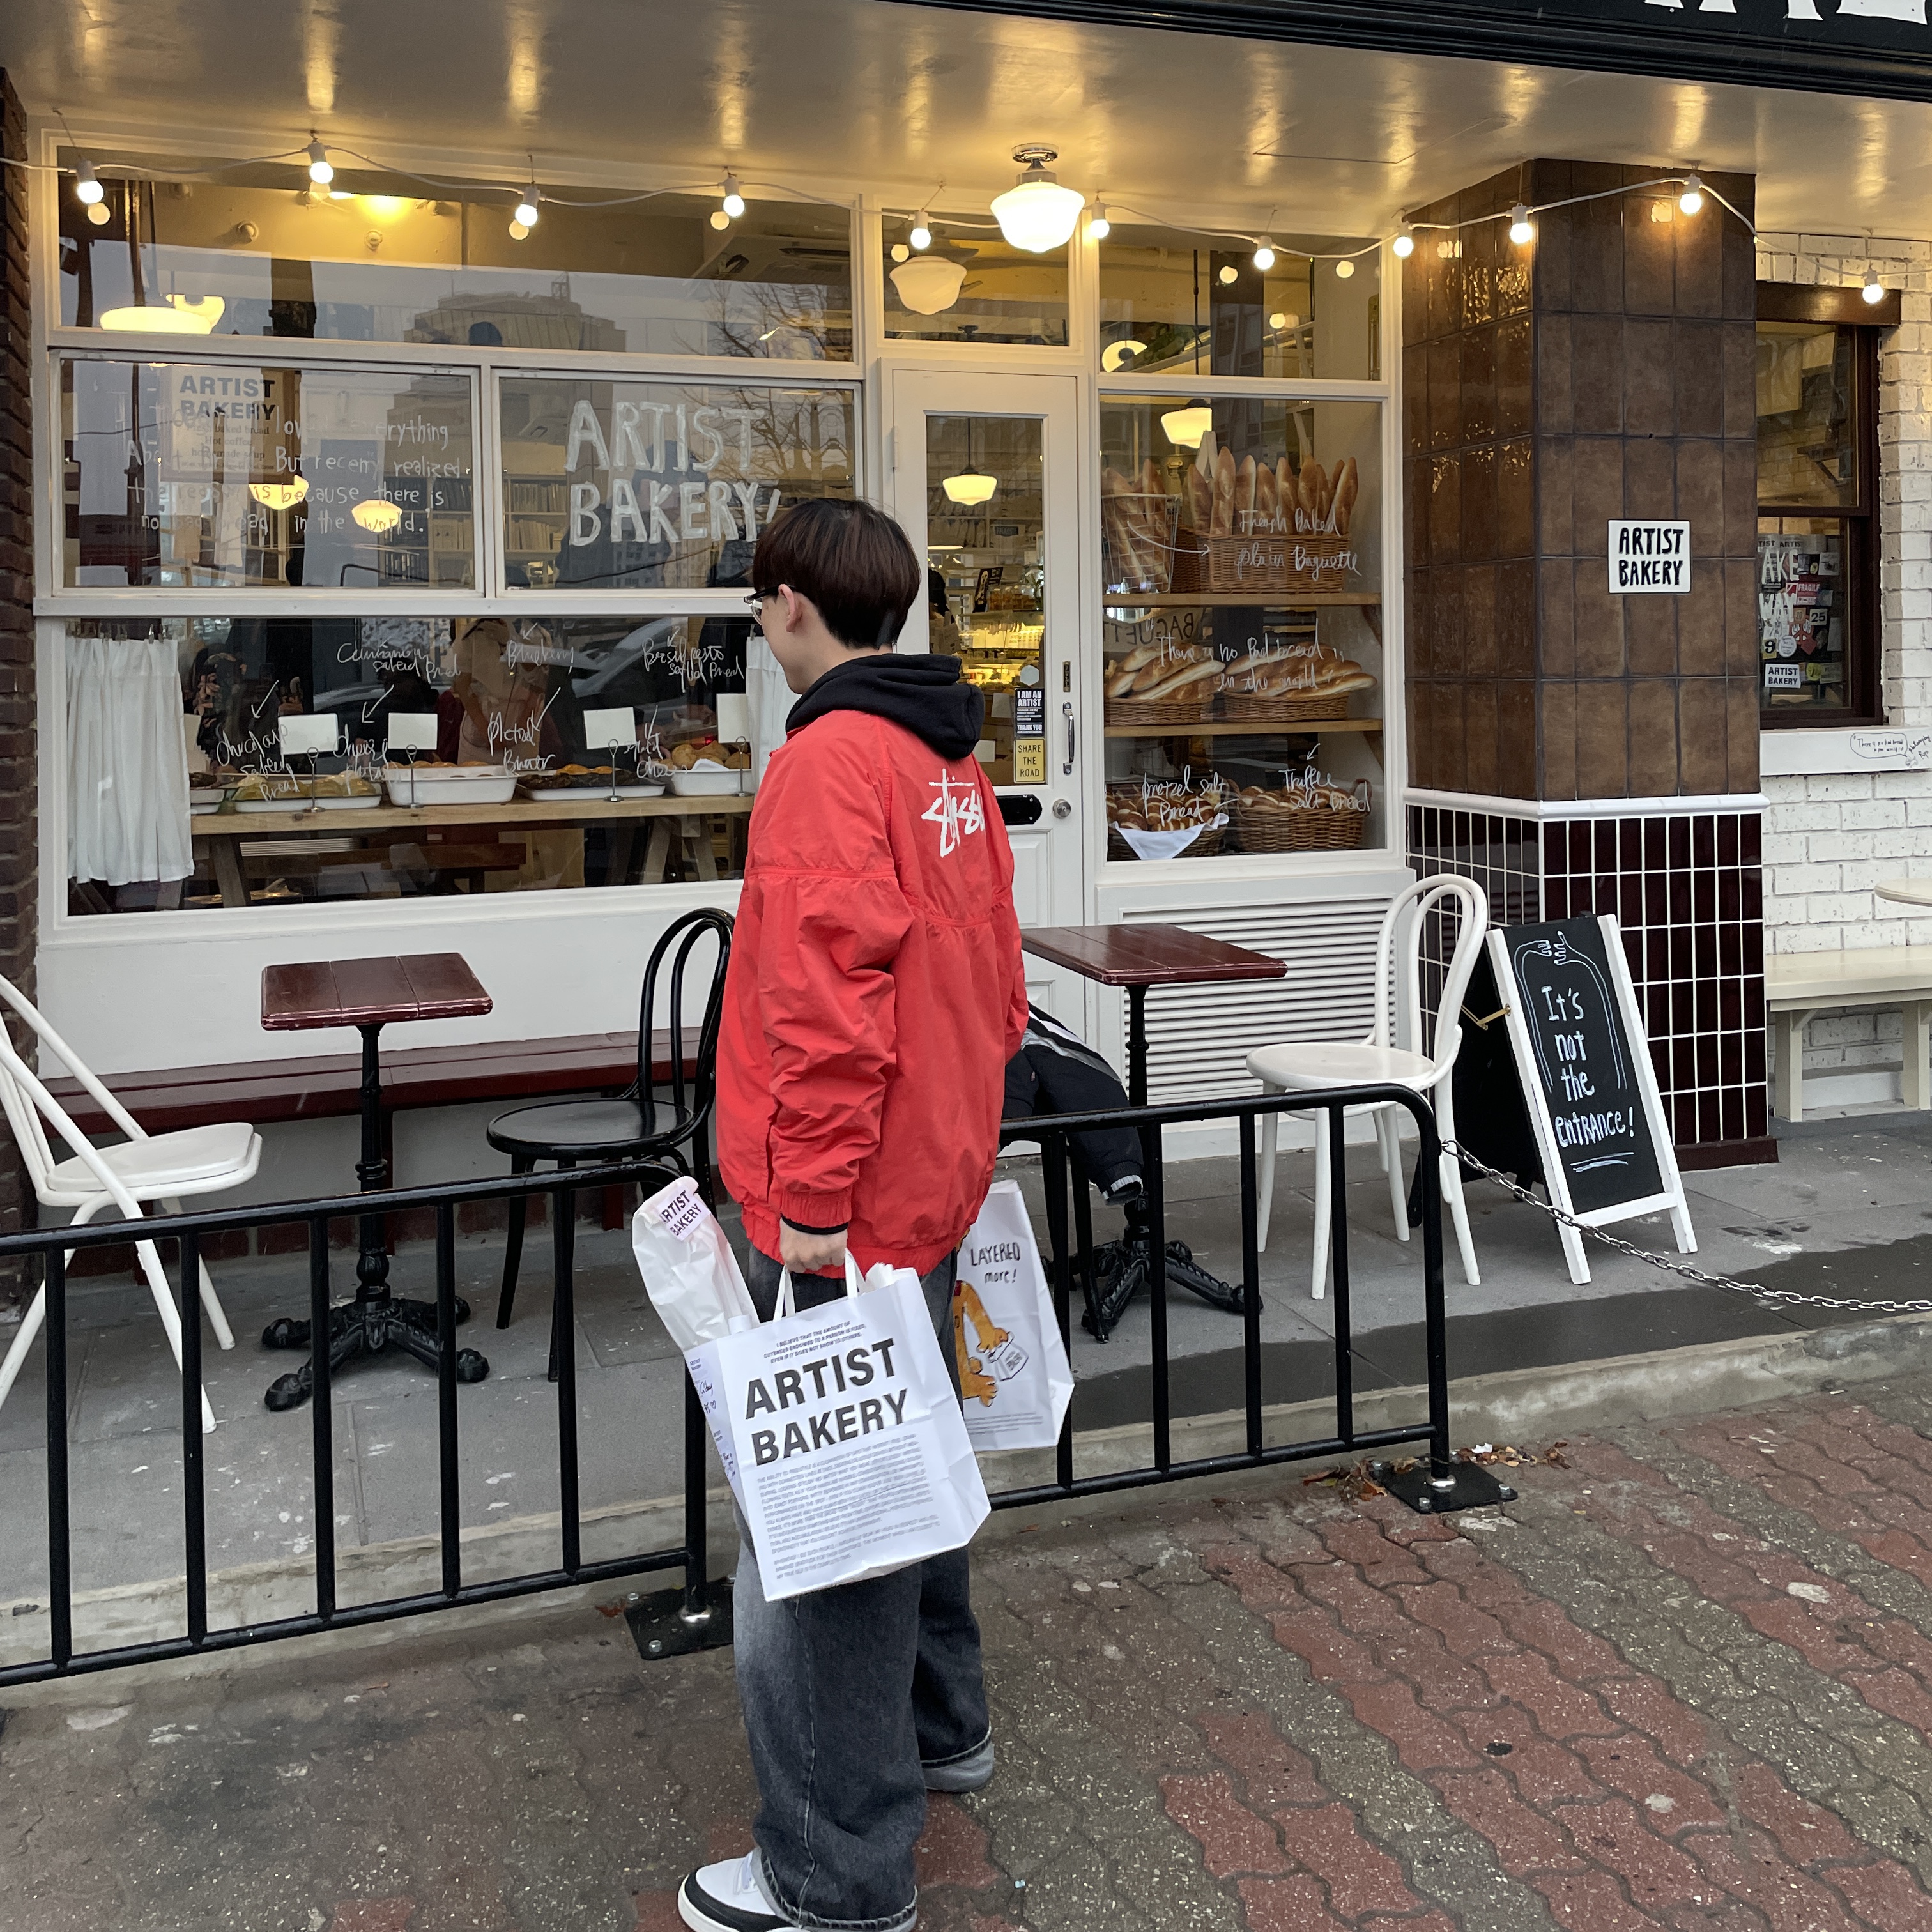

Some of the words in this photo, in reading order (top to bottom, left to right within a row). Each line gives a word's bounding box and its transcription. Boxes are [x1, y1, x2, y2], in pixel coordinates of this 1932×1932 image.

[180, 376, 275, 397] ARTIST
[181, 400, 275, 420] BAKERY
[205, 436, 221, 445] Hot
[564, 399, 765, 472] ARTIST
[275, 446, 305, 473] But
[253, 484, 271, 503] is
[281, 482, 359, 503] because
[374, 481, 419, 505] there
[429, 489, 445, 508] is
[141, 515, 159, 530] no
[295, 515, 307, 533] in
[318, 510, 345, 534] the
[1239, 505, 1287, 533] Fresh
[1295, 506, 1342, 537] Baked
[1619, 527, 1684, 555] ARTIST
[1291, 544, 1362, 581] Baguette
[1619, 560, 1683, 586] BAKERY
[1811, 613, 1826, 622] 25
[1219, 643, 1238, 662] no
[1765, 640, 1775, 654] 9
[1241, 668, 1268, 692] the
[1768, 667, 1798, 675] ARTIST
[1768, 677, 1798, 686] BAKERY
[1018, 698, 1041, 707] ARTIST
[1018, 744, 1042, 753] SHARE
[1023, 756, 1037, 765] THE
[1020, 769, 1039, 777] ROAD
[1541, 986, 1584, 1021] It's
[1554, 1031, 1586, 1061] not
[1561, 1064, 1595, 1101] the
[970, 1242, 1020, 1266] LAYERED
[985, 1269, 1016, 1284] more!
[779, 1337, 799, 1347] BELIEVE
[825, 1331, 845, 1339] PERSON
[746, 1338, 894, 1420] ARTIST
[751, 1388, 908, 1466] BAKERY
